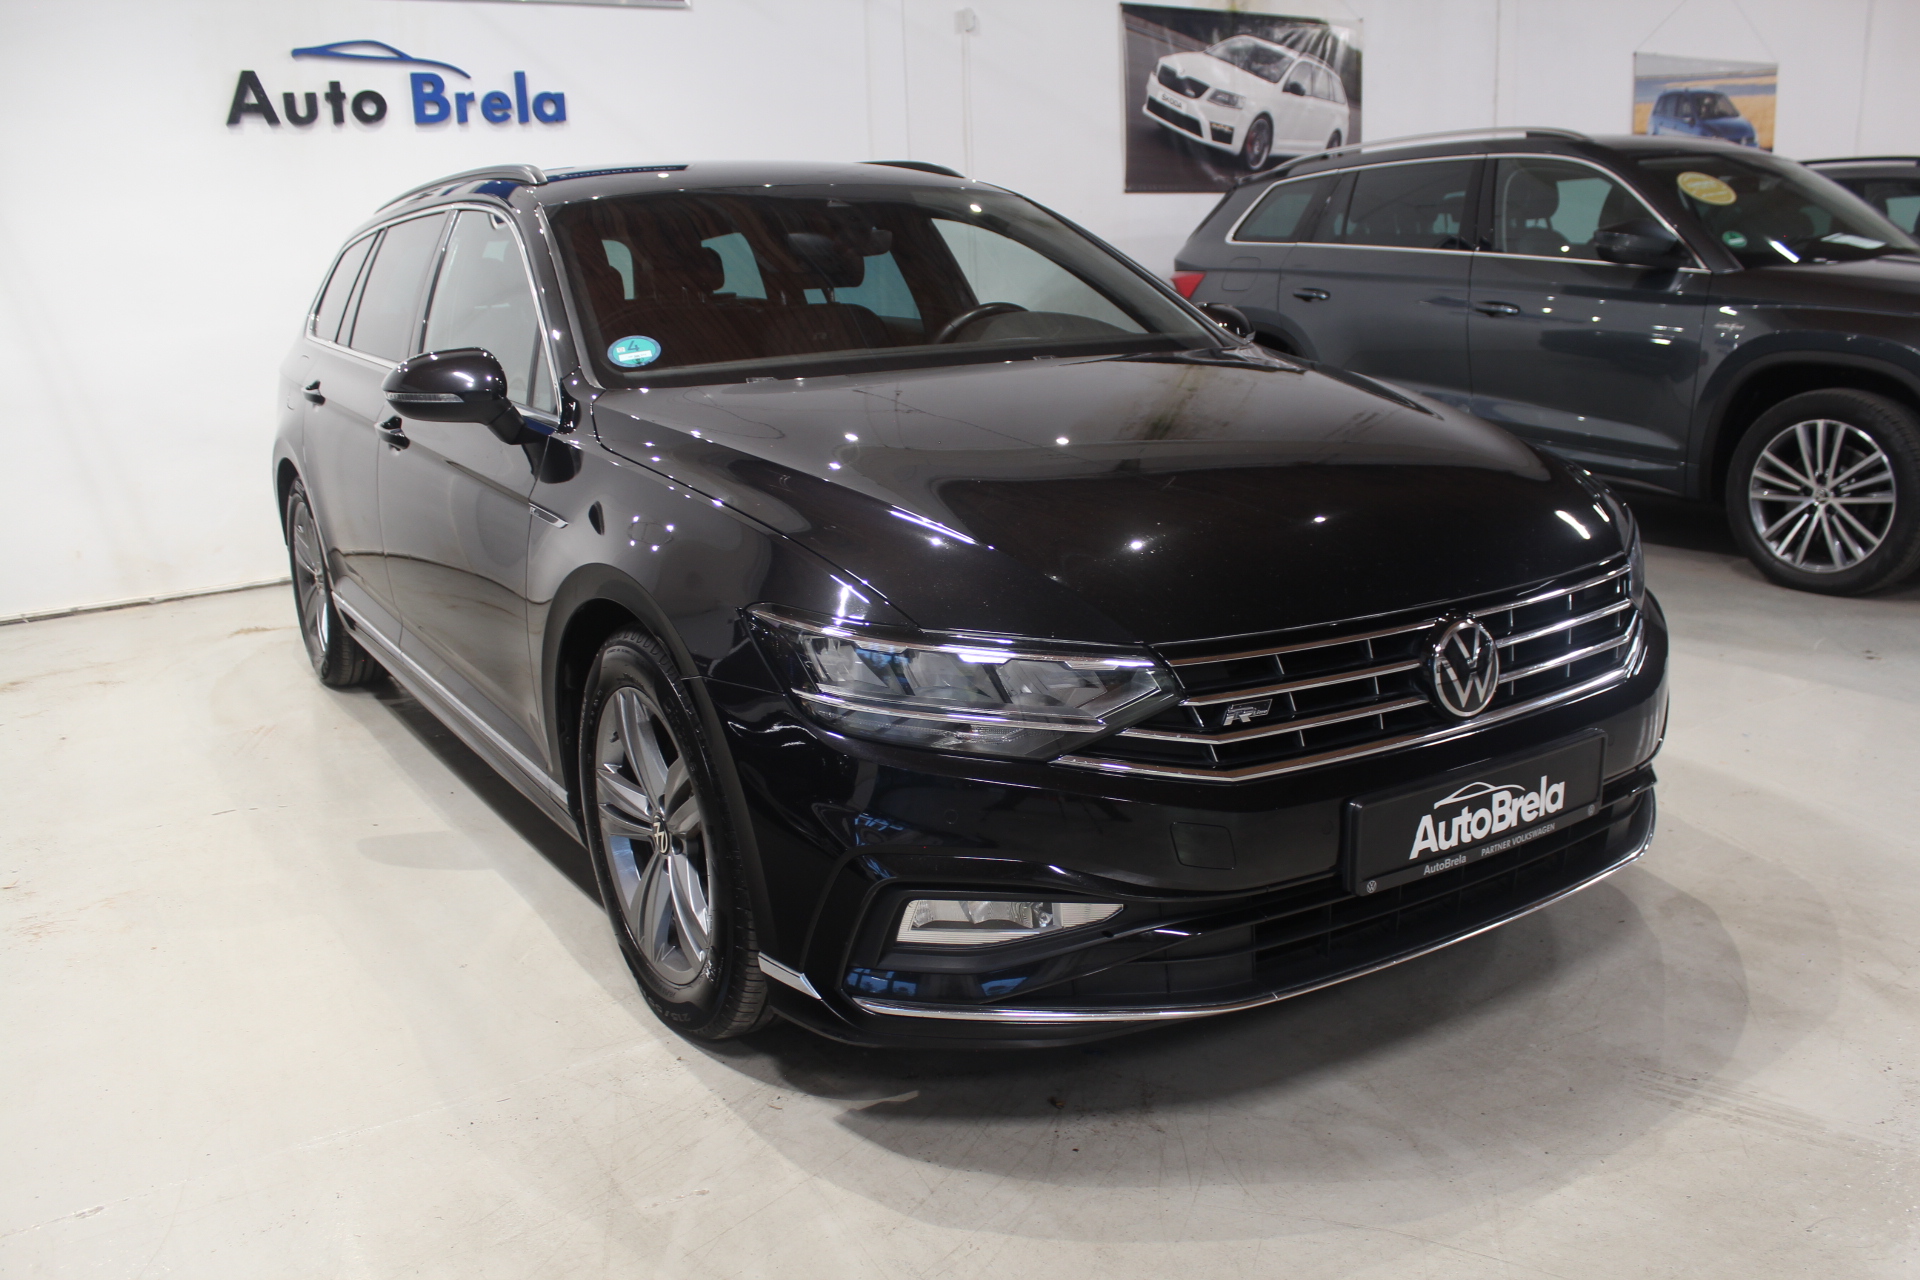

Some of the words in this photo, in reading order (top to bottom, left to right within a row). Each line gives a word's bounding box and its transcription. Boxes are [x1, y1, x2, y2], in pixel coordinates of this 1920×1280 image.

[226, 70, 388, 126] Auto
[409, 70, 567, 125] Brela
[1409, 775, 1566, 860] AutoBrela
[1480, 839, 1511, 857] PARTNER
[1511, 822, 1556, 846] VOLKSWAGEN
[1423, 853, 1467, 876] AutoBrela
